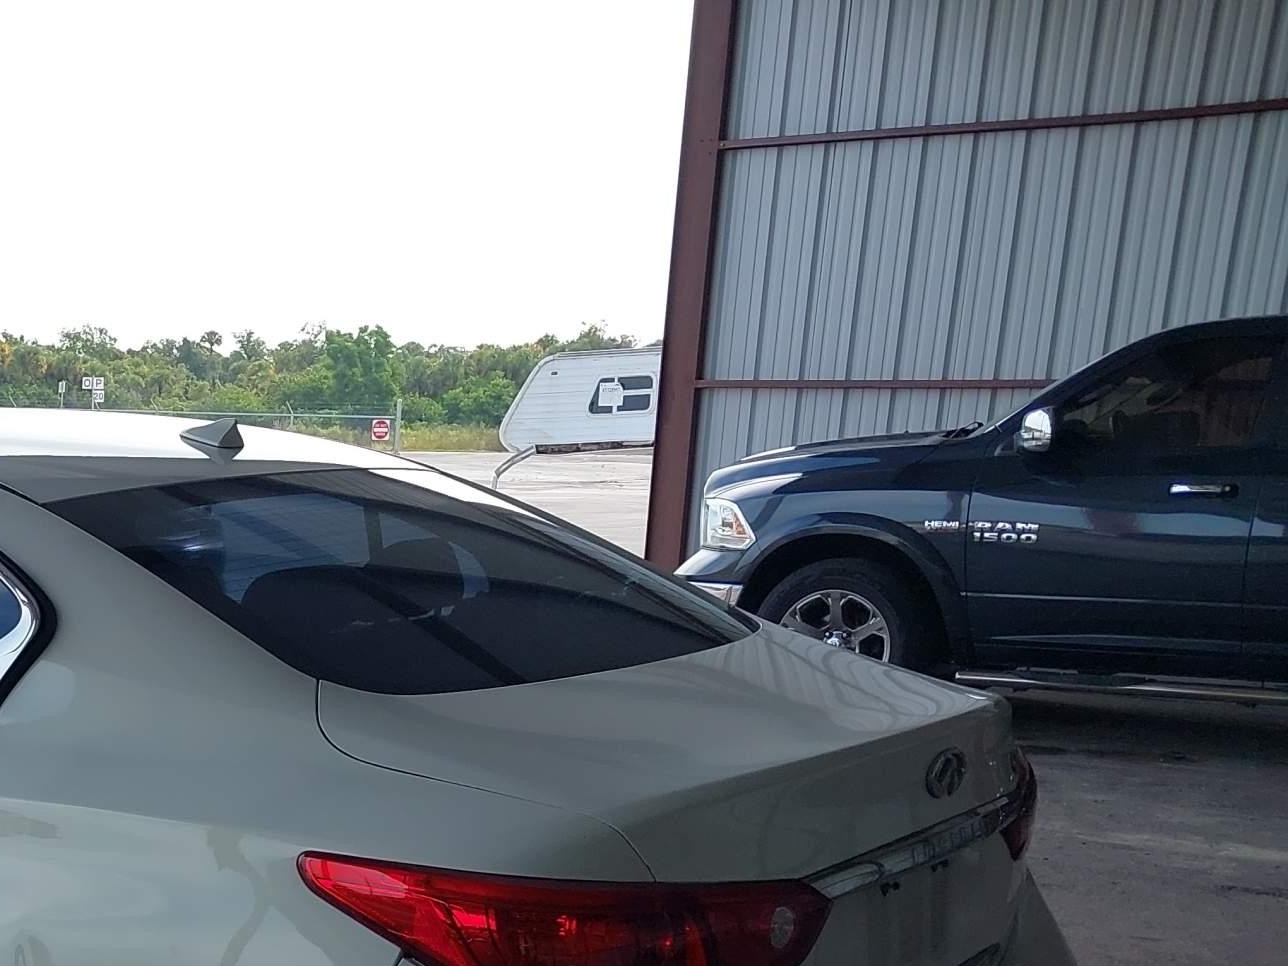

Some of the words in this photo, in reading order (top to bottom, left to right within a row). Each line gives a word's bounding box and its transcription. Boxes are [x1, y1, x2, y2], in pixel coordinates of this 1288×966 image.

[95, 378, 103, 388] P
[93, 392, 104, 401] 20
[924, 520, 960, 529] HEMI
[974, 521, 1040, 531] RAM
[973, 532, 1038, 543] 1500
